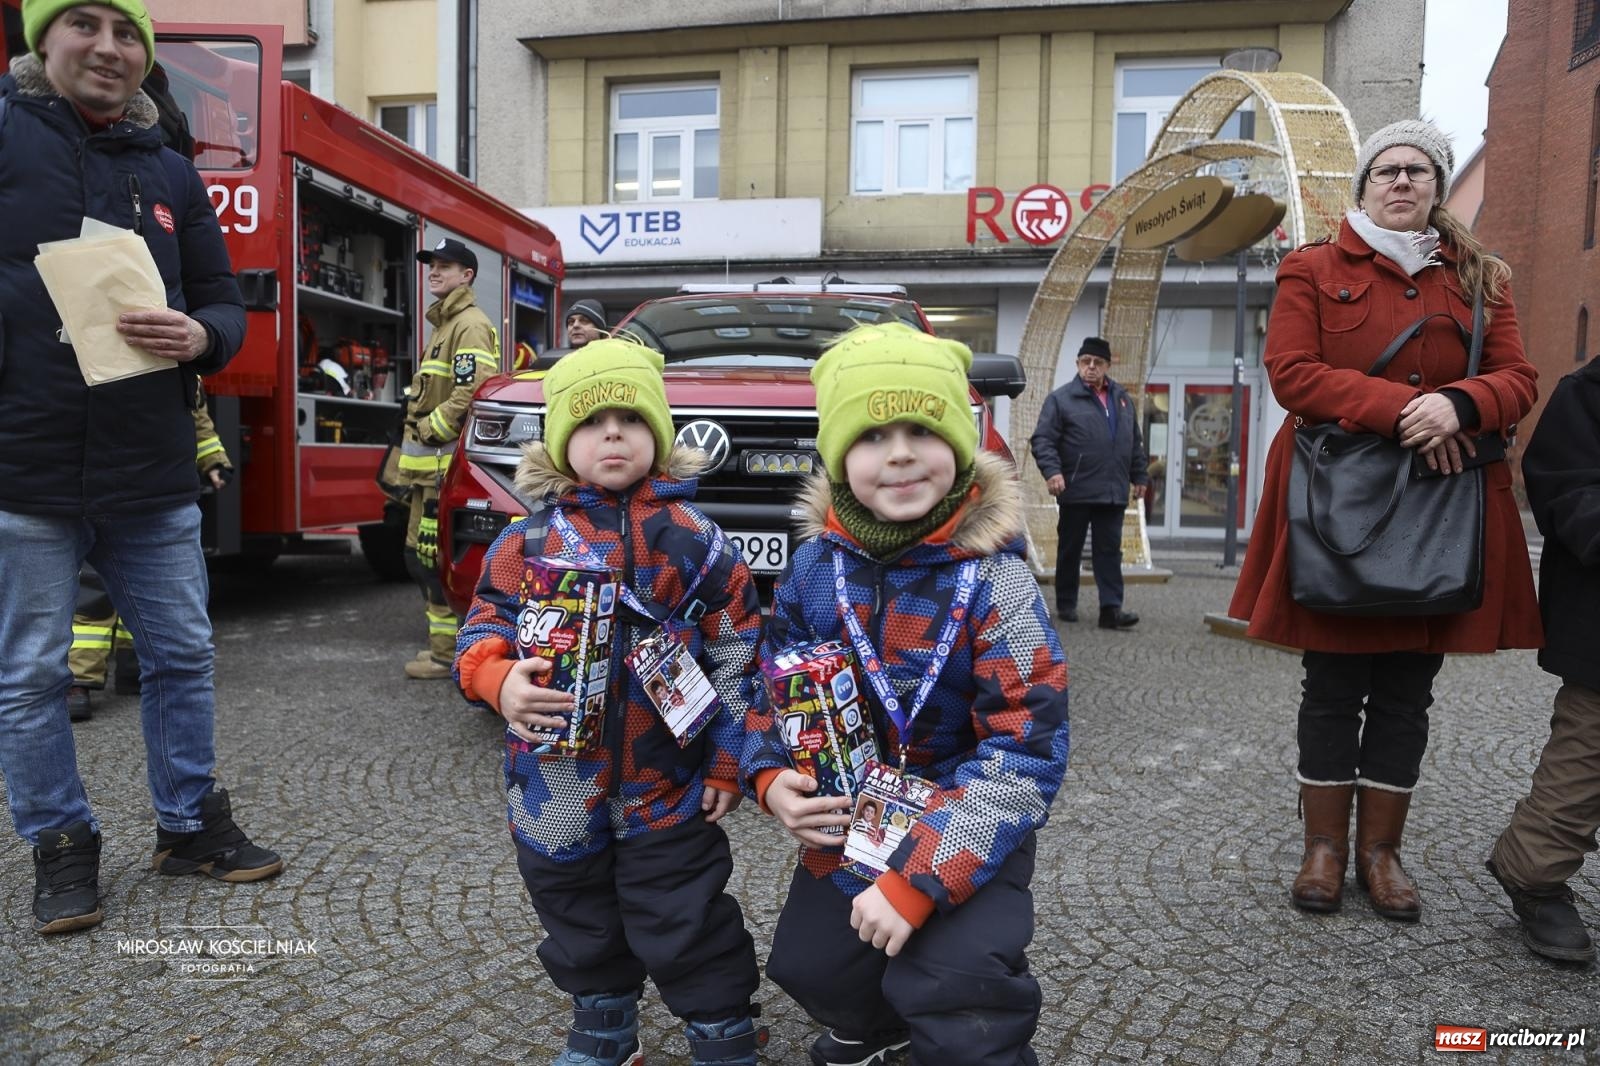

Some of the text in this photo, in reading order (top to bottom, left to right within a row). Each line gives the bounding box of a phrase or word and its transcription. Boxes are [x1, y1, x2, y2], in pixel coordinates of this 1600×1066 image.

[207, 185, 258, 233] 29
[626, 210, 681, 233] TEB
[1135, 190, 1206, 235] Wesołych Świąt
[624, 237, 681, 247] EDUKACJA
[569, 381, 637, 419] GRINCH
[867, 389, 947, 422] GRINCH
[519, 608, 564, 645] 34
[857, 640, 872, 658] 112
[869, 767, 880, 779] A
[906, 786, 932, 803] 34
